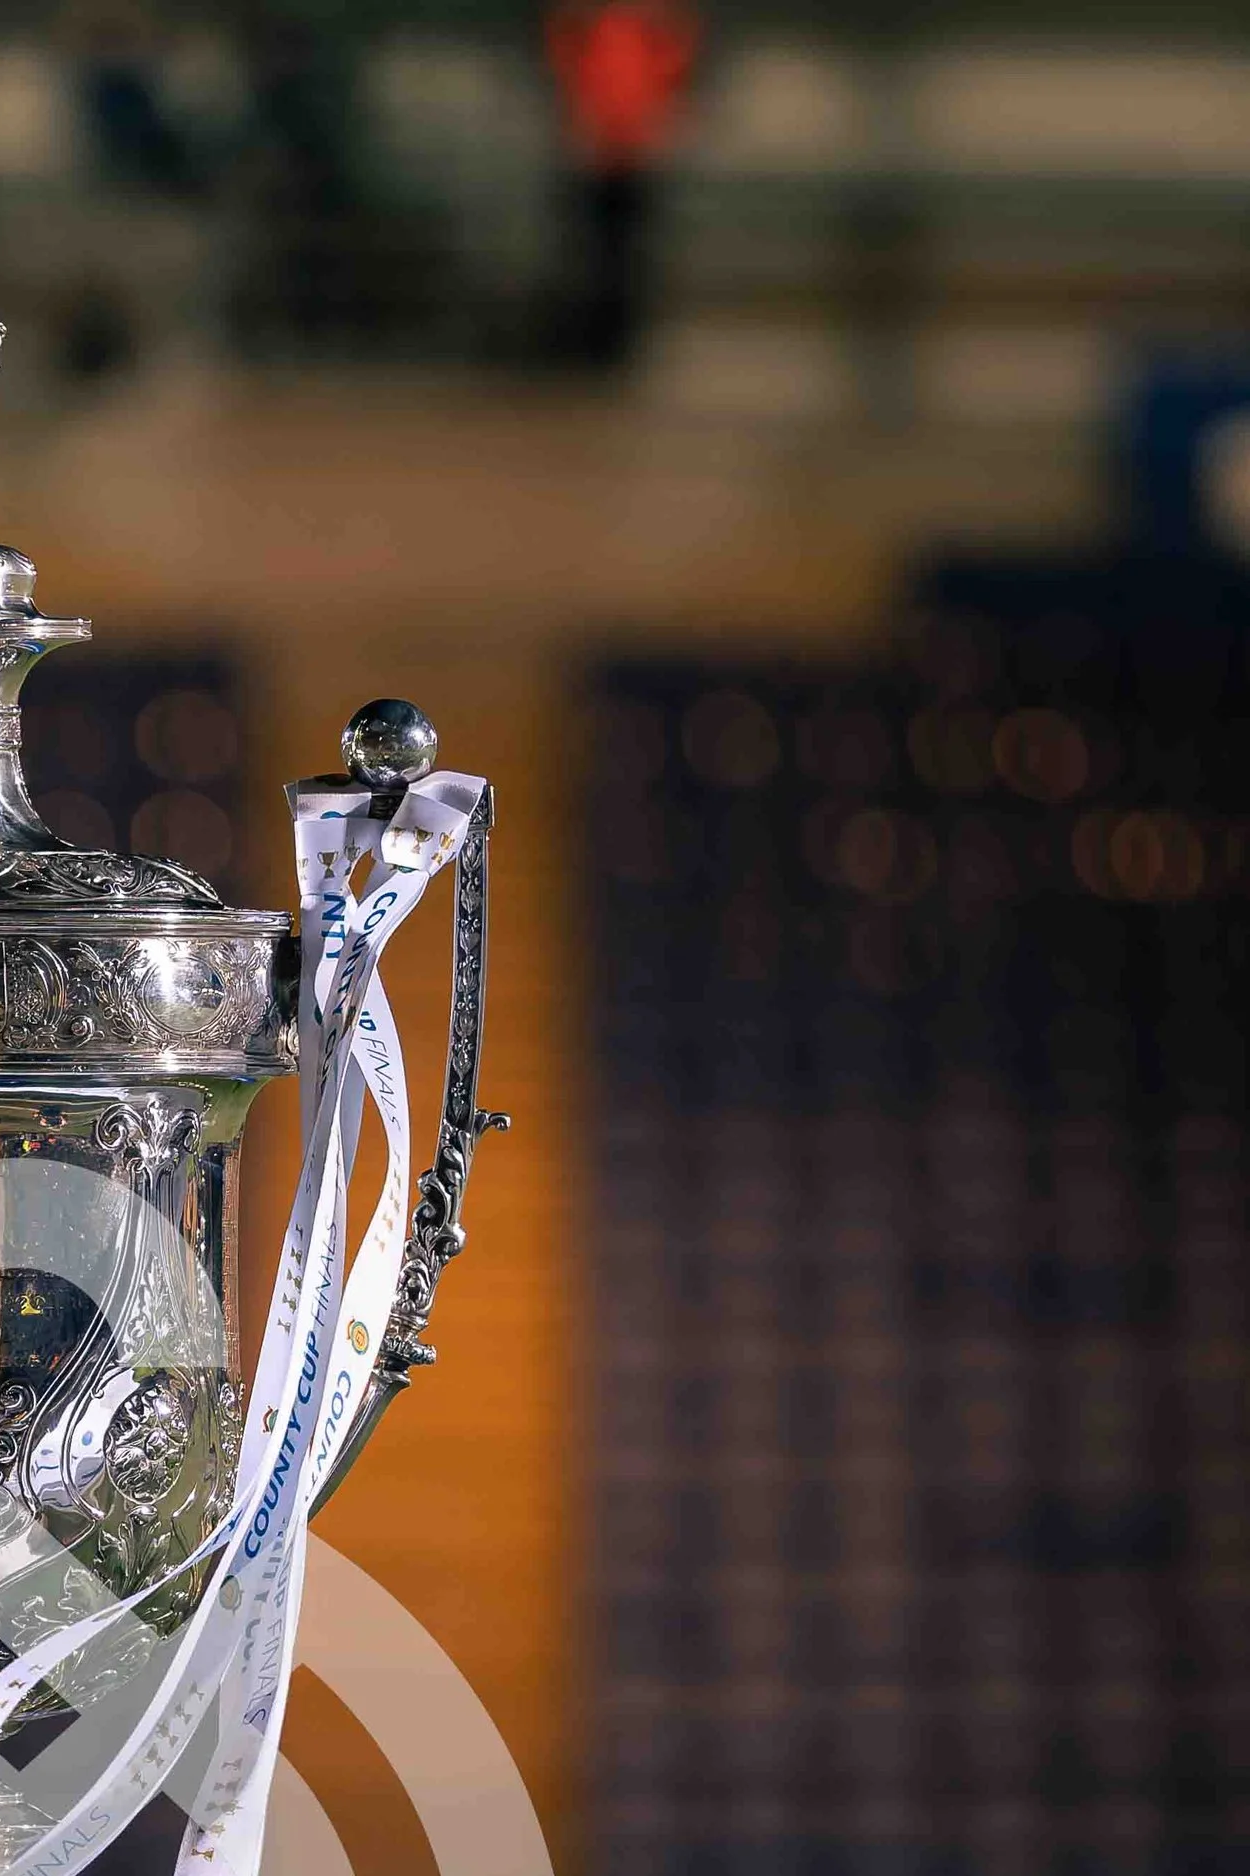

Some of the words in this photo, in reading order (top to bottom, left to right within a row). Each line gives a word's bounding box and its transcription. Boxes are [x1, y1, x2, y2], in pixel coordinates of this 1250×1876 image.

[359, 1035, 402, 1134] FINALS
[243, 1410, 303, 1559] COUNTY
[296, 1331, 320, 1404] CUP
[313, 1222, 338, 1328] FINALS
[242, 1617, 283, 1725] FINALS
